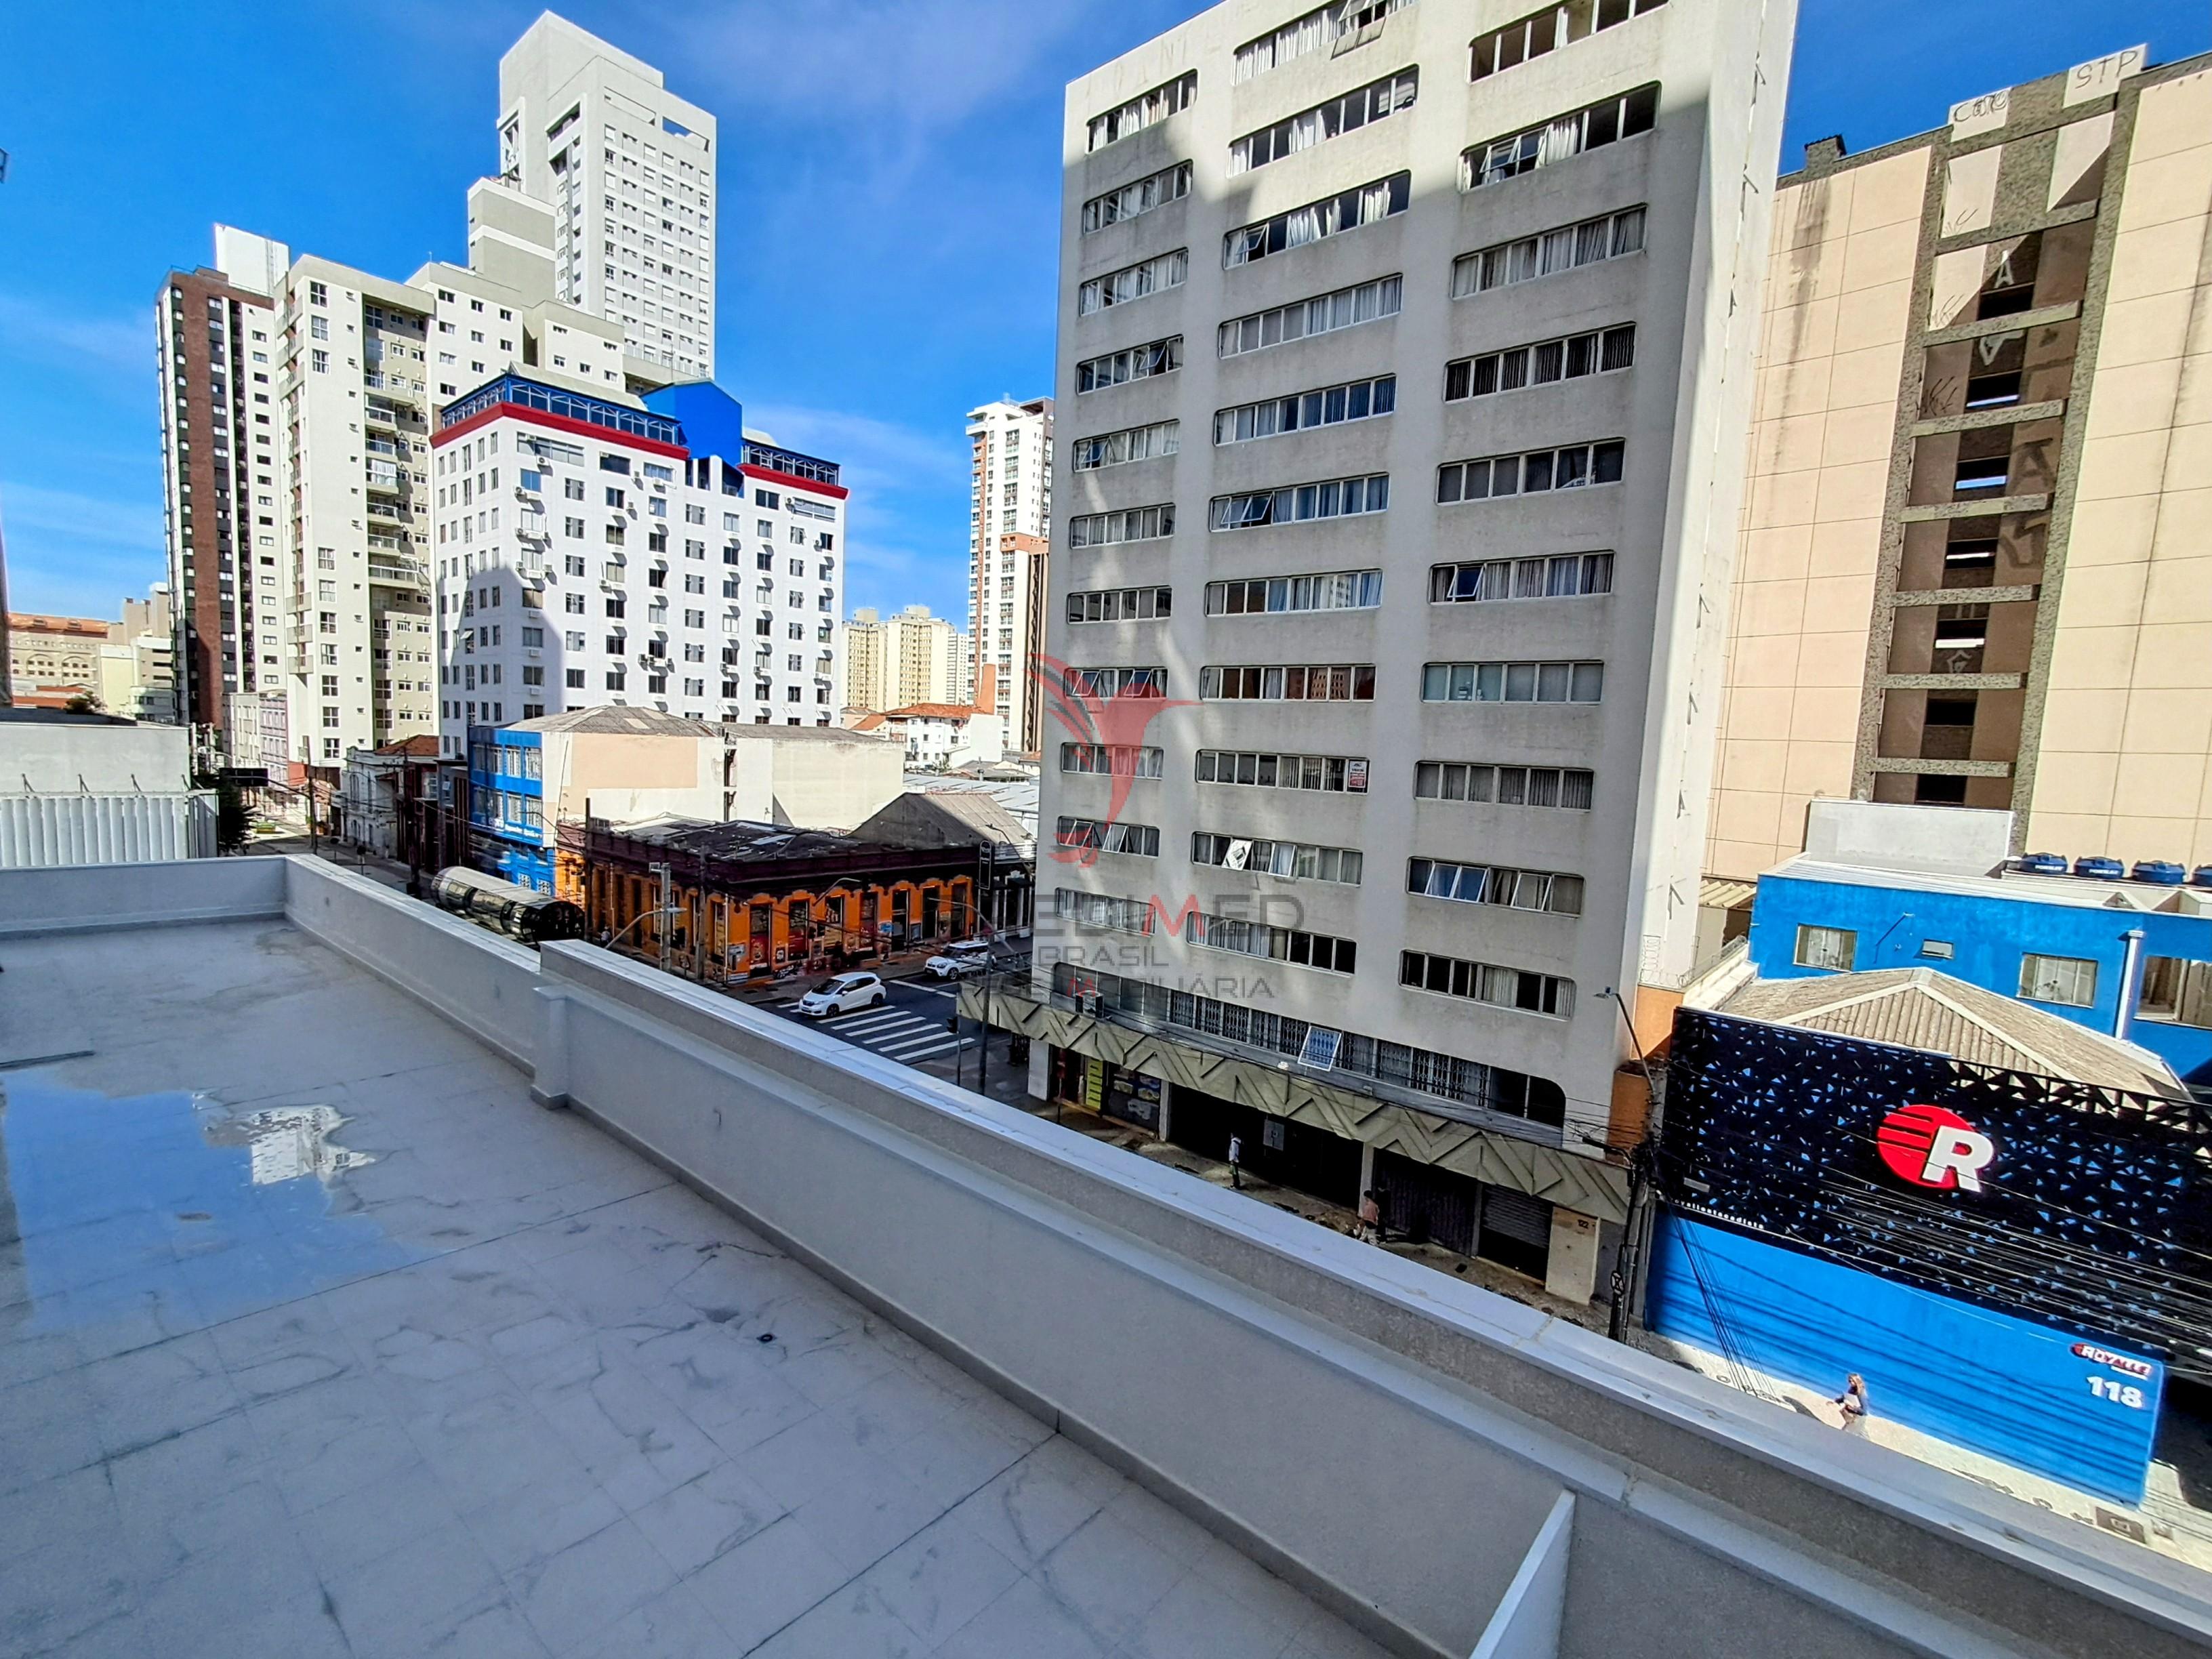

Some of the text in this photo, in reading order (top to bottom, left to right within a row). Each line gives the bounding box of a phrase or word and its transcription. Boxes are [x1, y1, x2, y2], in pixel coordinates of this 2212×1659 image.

[2075, 49, 2137, 89] STP
[1922, 1125, 1994, 1193] R
[2081, 1345, 2152, 1376] ROYALLE
[2086, 1376, 2144, 1409] 118
